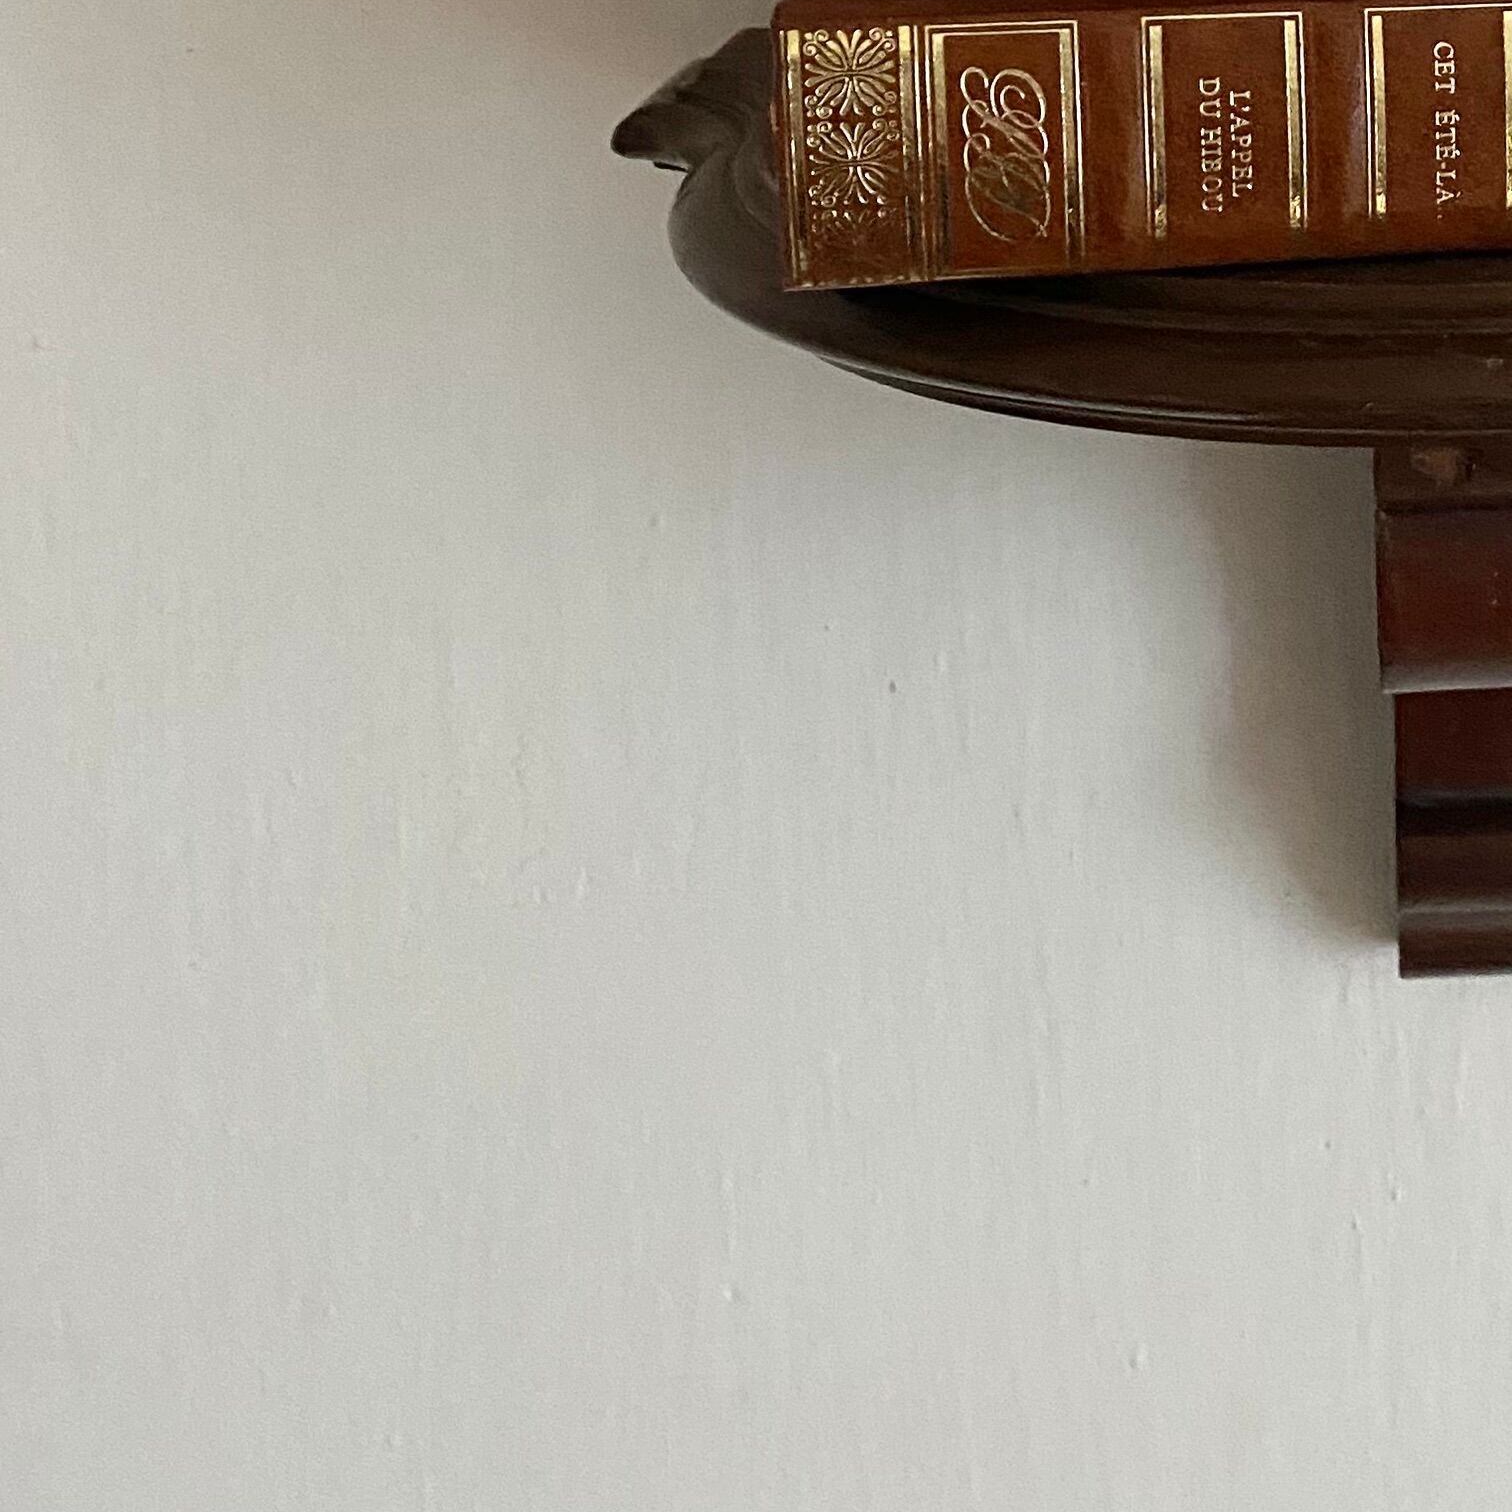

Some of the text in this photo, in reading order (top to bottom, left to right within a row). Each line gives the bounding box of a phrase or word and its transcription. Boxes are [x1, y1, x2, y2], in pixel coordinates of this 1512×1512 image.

[1433, 41, 1456, 94] CET
[1199, 77, 1223, 213] DU HIBOU
[1229, 90, 1253, 198] L'APPEL
